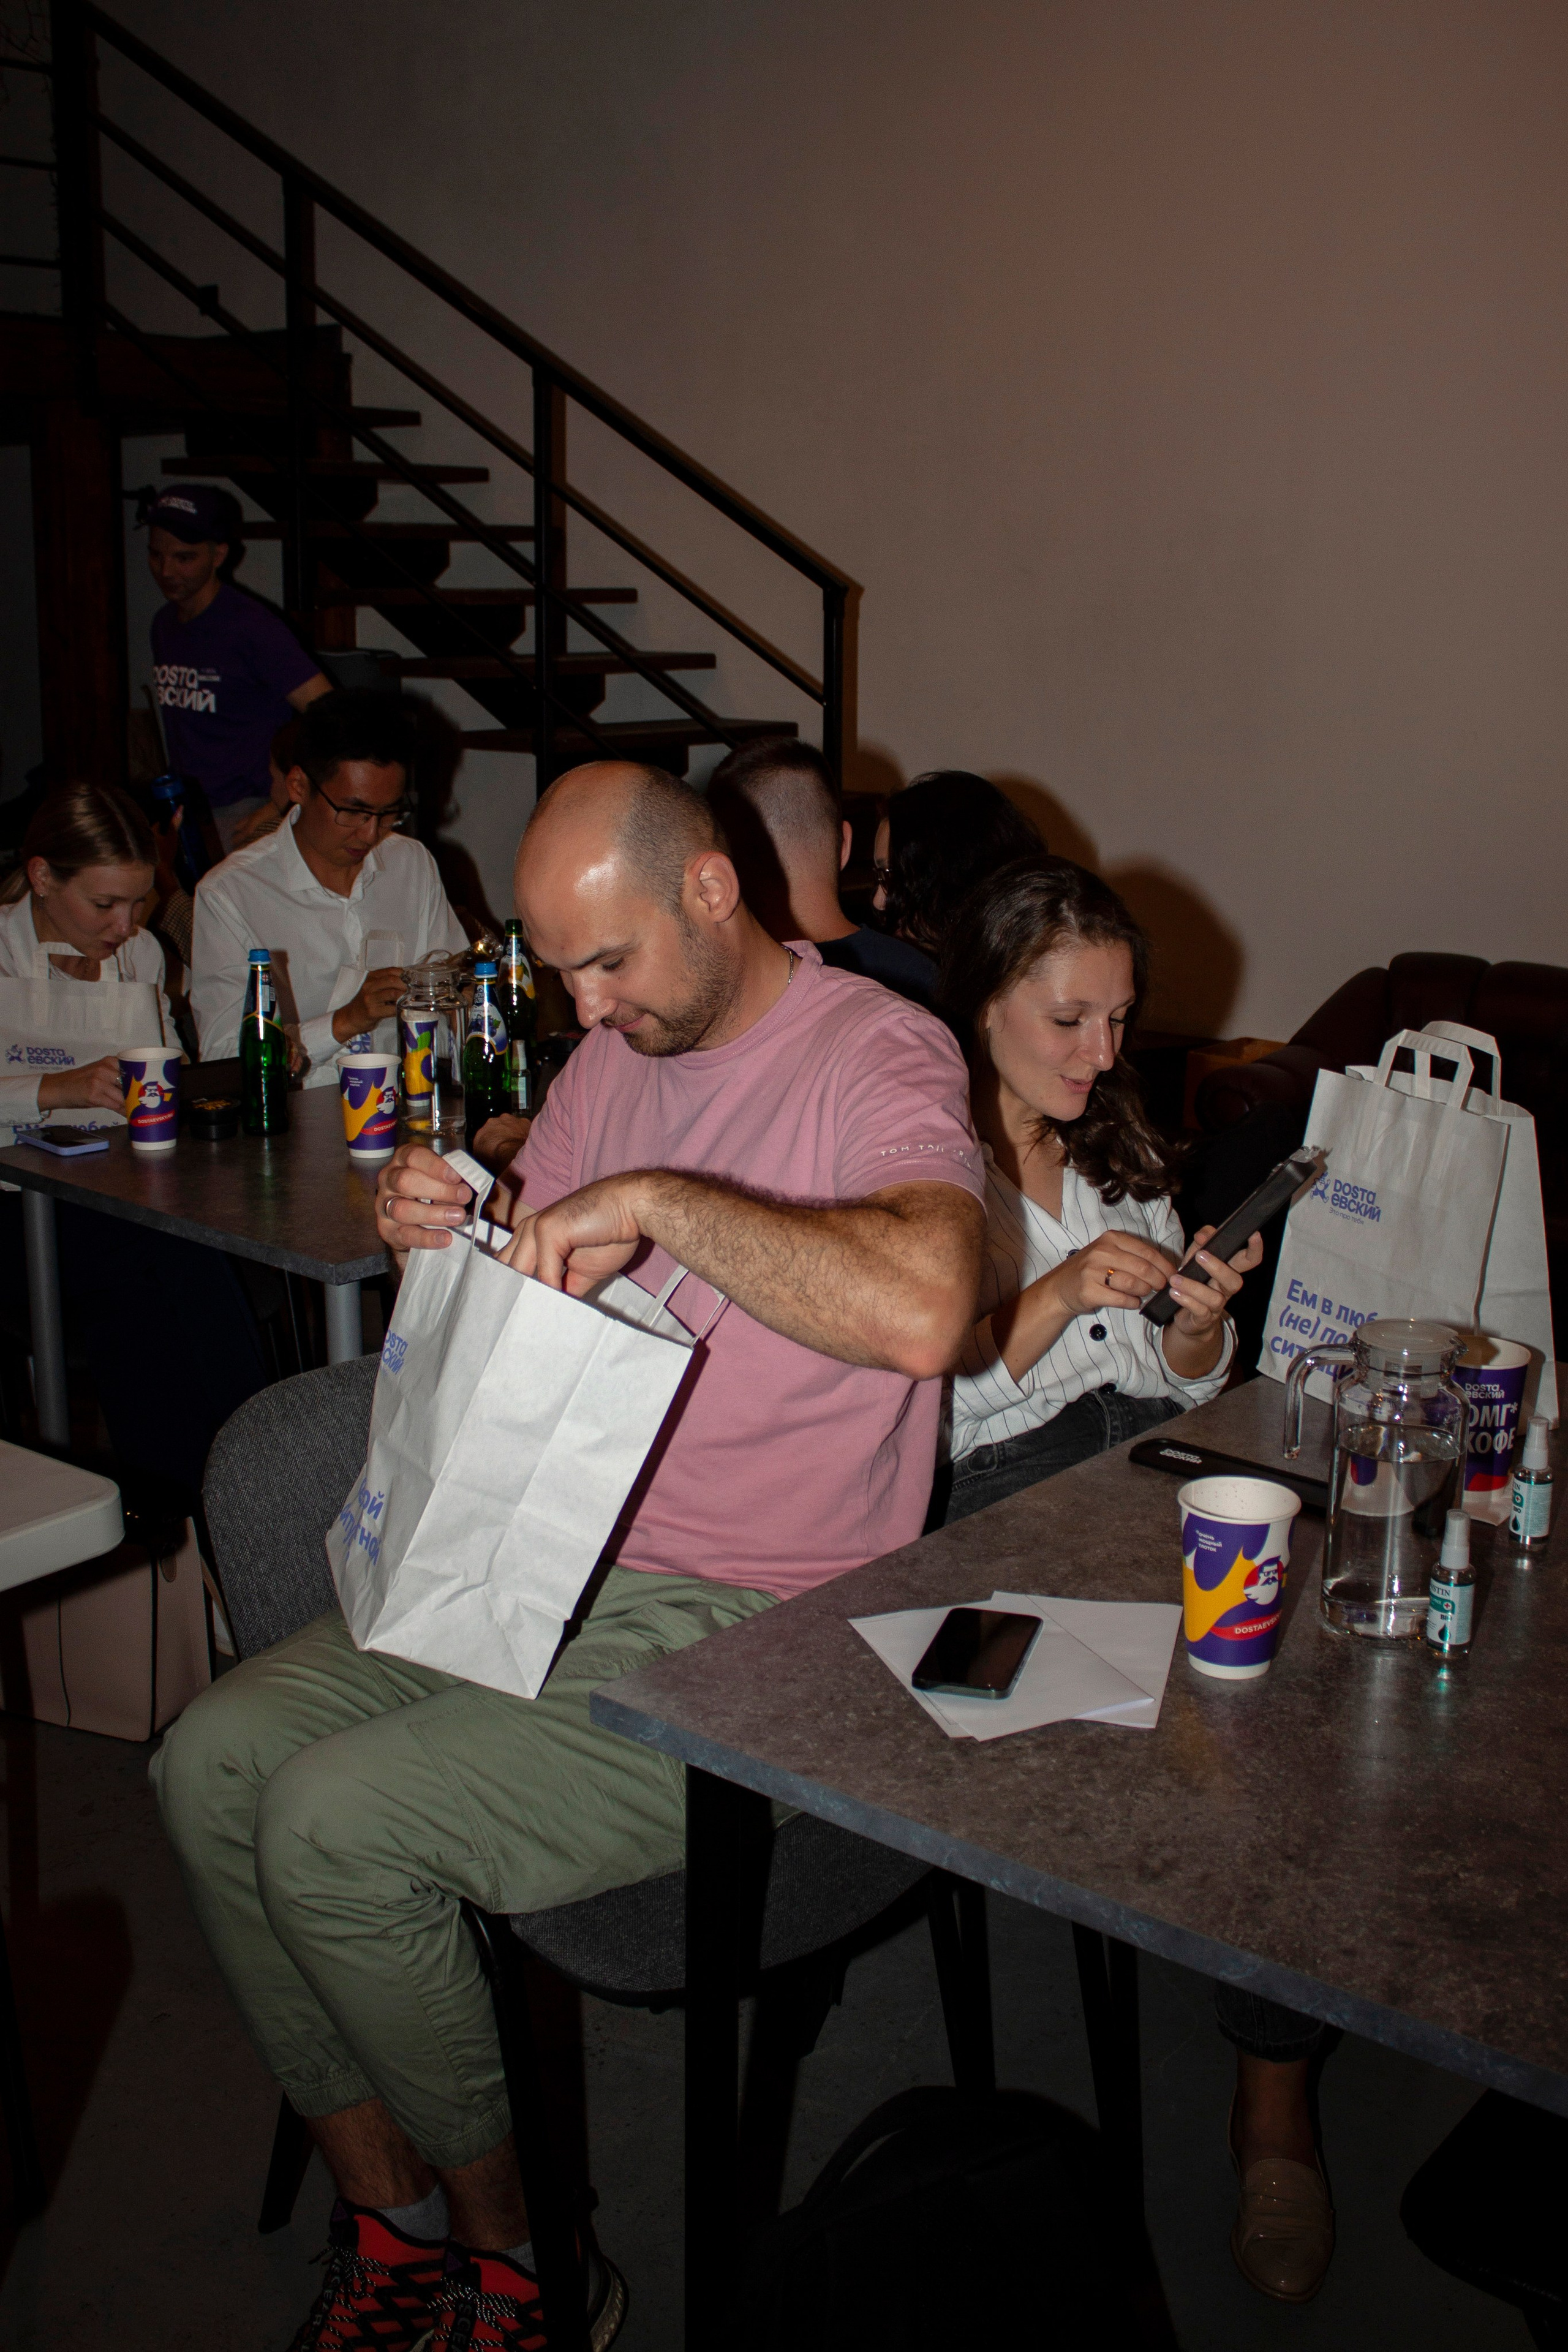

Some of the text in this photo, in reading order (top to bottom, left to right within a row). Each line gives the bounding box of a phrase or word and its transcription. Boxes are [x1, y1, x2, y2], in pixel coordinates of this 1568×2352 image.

[881, 1147, 909, 1156] TOM
[1287, 1279, 1378, 1329] Ем в люб
